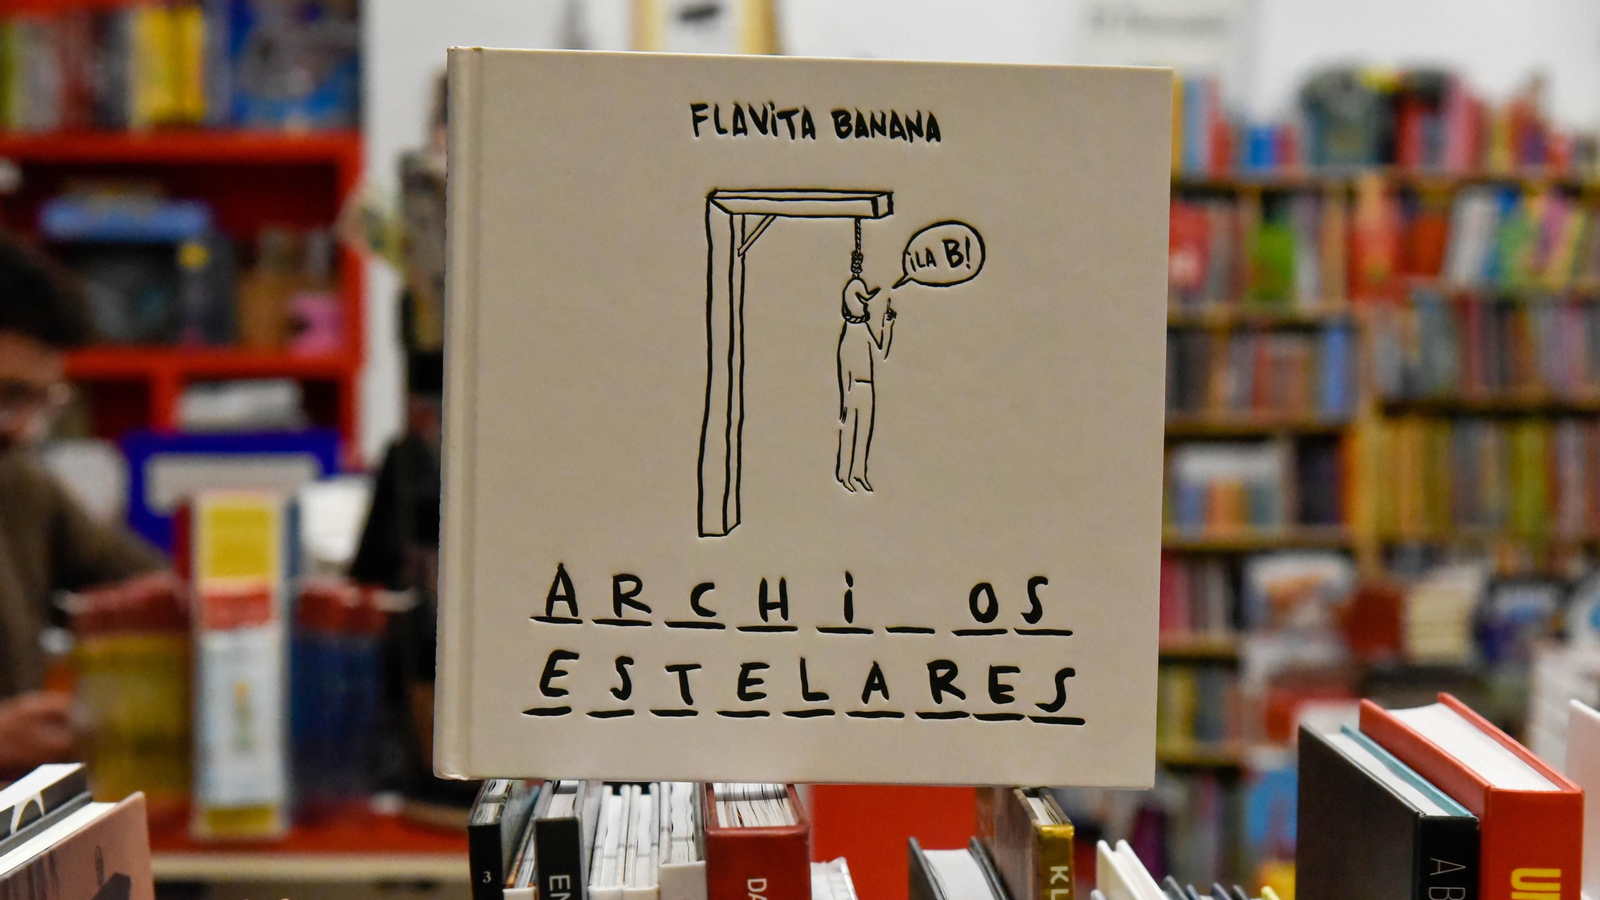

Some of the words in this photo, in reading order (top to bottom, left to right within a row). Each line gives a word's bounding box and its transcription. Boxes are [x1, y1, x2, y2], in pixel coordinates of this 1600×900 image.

[831, 107, 942, 143] BANANA
[942, 235, 971, 270] B!
[539, 649, 1076, 713] ESTELARES
[482, 870, 492, 883] 3
